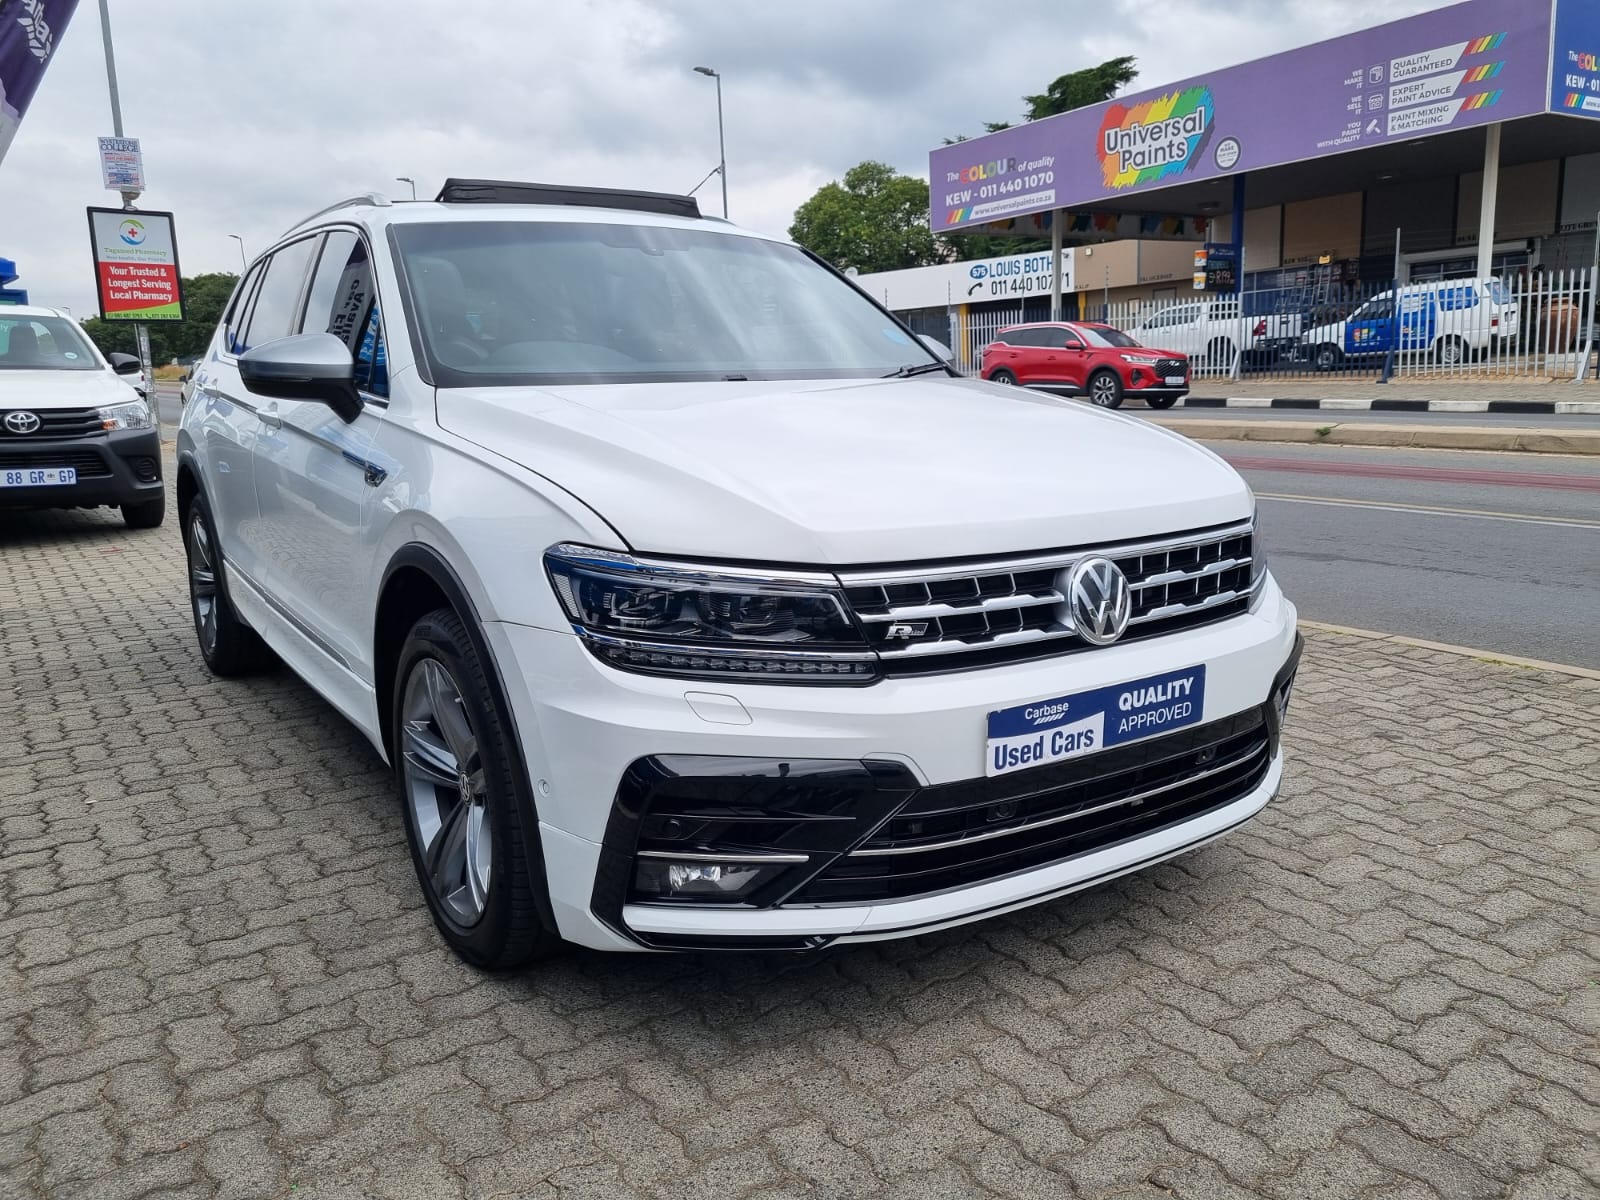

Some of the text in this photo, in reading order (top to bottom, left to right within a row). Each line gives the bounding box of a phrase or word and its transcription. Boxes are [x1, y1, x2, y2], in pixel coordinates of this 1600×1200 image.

[1393, 54, 1430, 70] QUALITY
[1568, 50, 1578, 62] The
[1352, 69, 1363, 77] WE
[1392, 58, 1453, 79] GUARANTEED
[1344, 76, 1363, 86] MAKE
[1566, 73, 1586, 89] KEW
[1391, 86, 1452, 105] PAINT ADVICE
[1392, 83, 1425, 97] EXPERT
[1347, 102, 1362, 111] SELL
[1391, 105, 1449, 123] PAINT MIXING
[1106, 108, 1204, 152] Universal
[1347, 121, 1361, 129] YOU
[1397, 115, 1444, 131] MATCHING
[1341, 128, 1361, 137] PAINT
[1317, 134, 1361, 148] WITH QUALITY
[1121, 139, 1186, 172] Paints
[946, 155, 1055, 185] The COLOUR of quality
[945, 189, 972, 207] KEW
[980, 183, 997, 199] 011
[999, 178, 1022, 194] 440
[1024, 171, 1054, 189] 1070
[974, 194, 1052, 216] www.universalpaints.co.za
[109, 265, 167, 277] Your Trusted &
[989, 260, 1021, 278] LOUIS
[108, 278, 172, 291] Longest Serving
[991, 279, 1007, 295] 011
[1010, 277, 1033, 293] 440
[110, 290, 173, 302] Local Pharmacy
[6, 469, 74, 485] 88 GR GP
[1118, 676, 1194, 711] QUALITY
[1025, 701, 1070, 720] Carbase
[1118, 701, 1192, 734] APPROVED
[993, 727, 1095, 770] Used Cars
